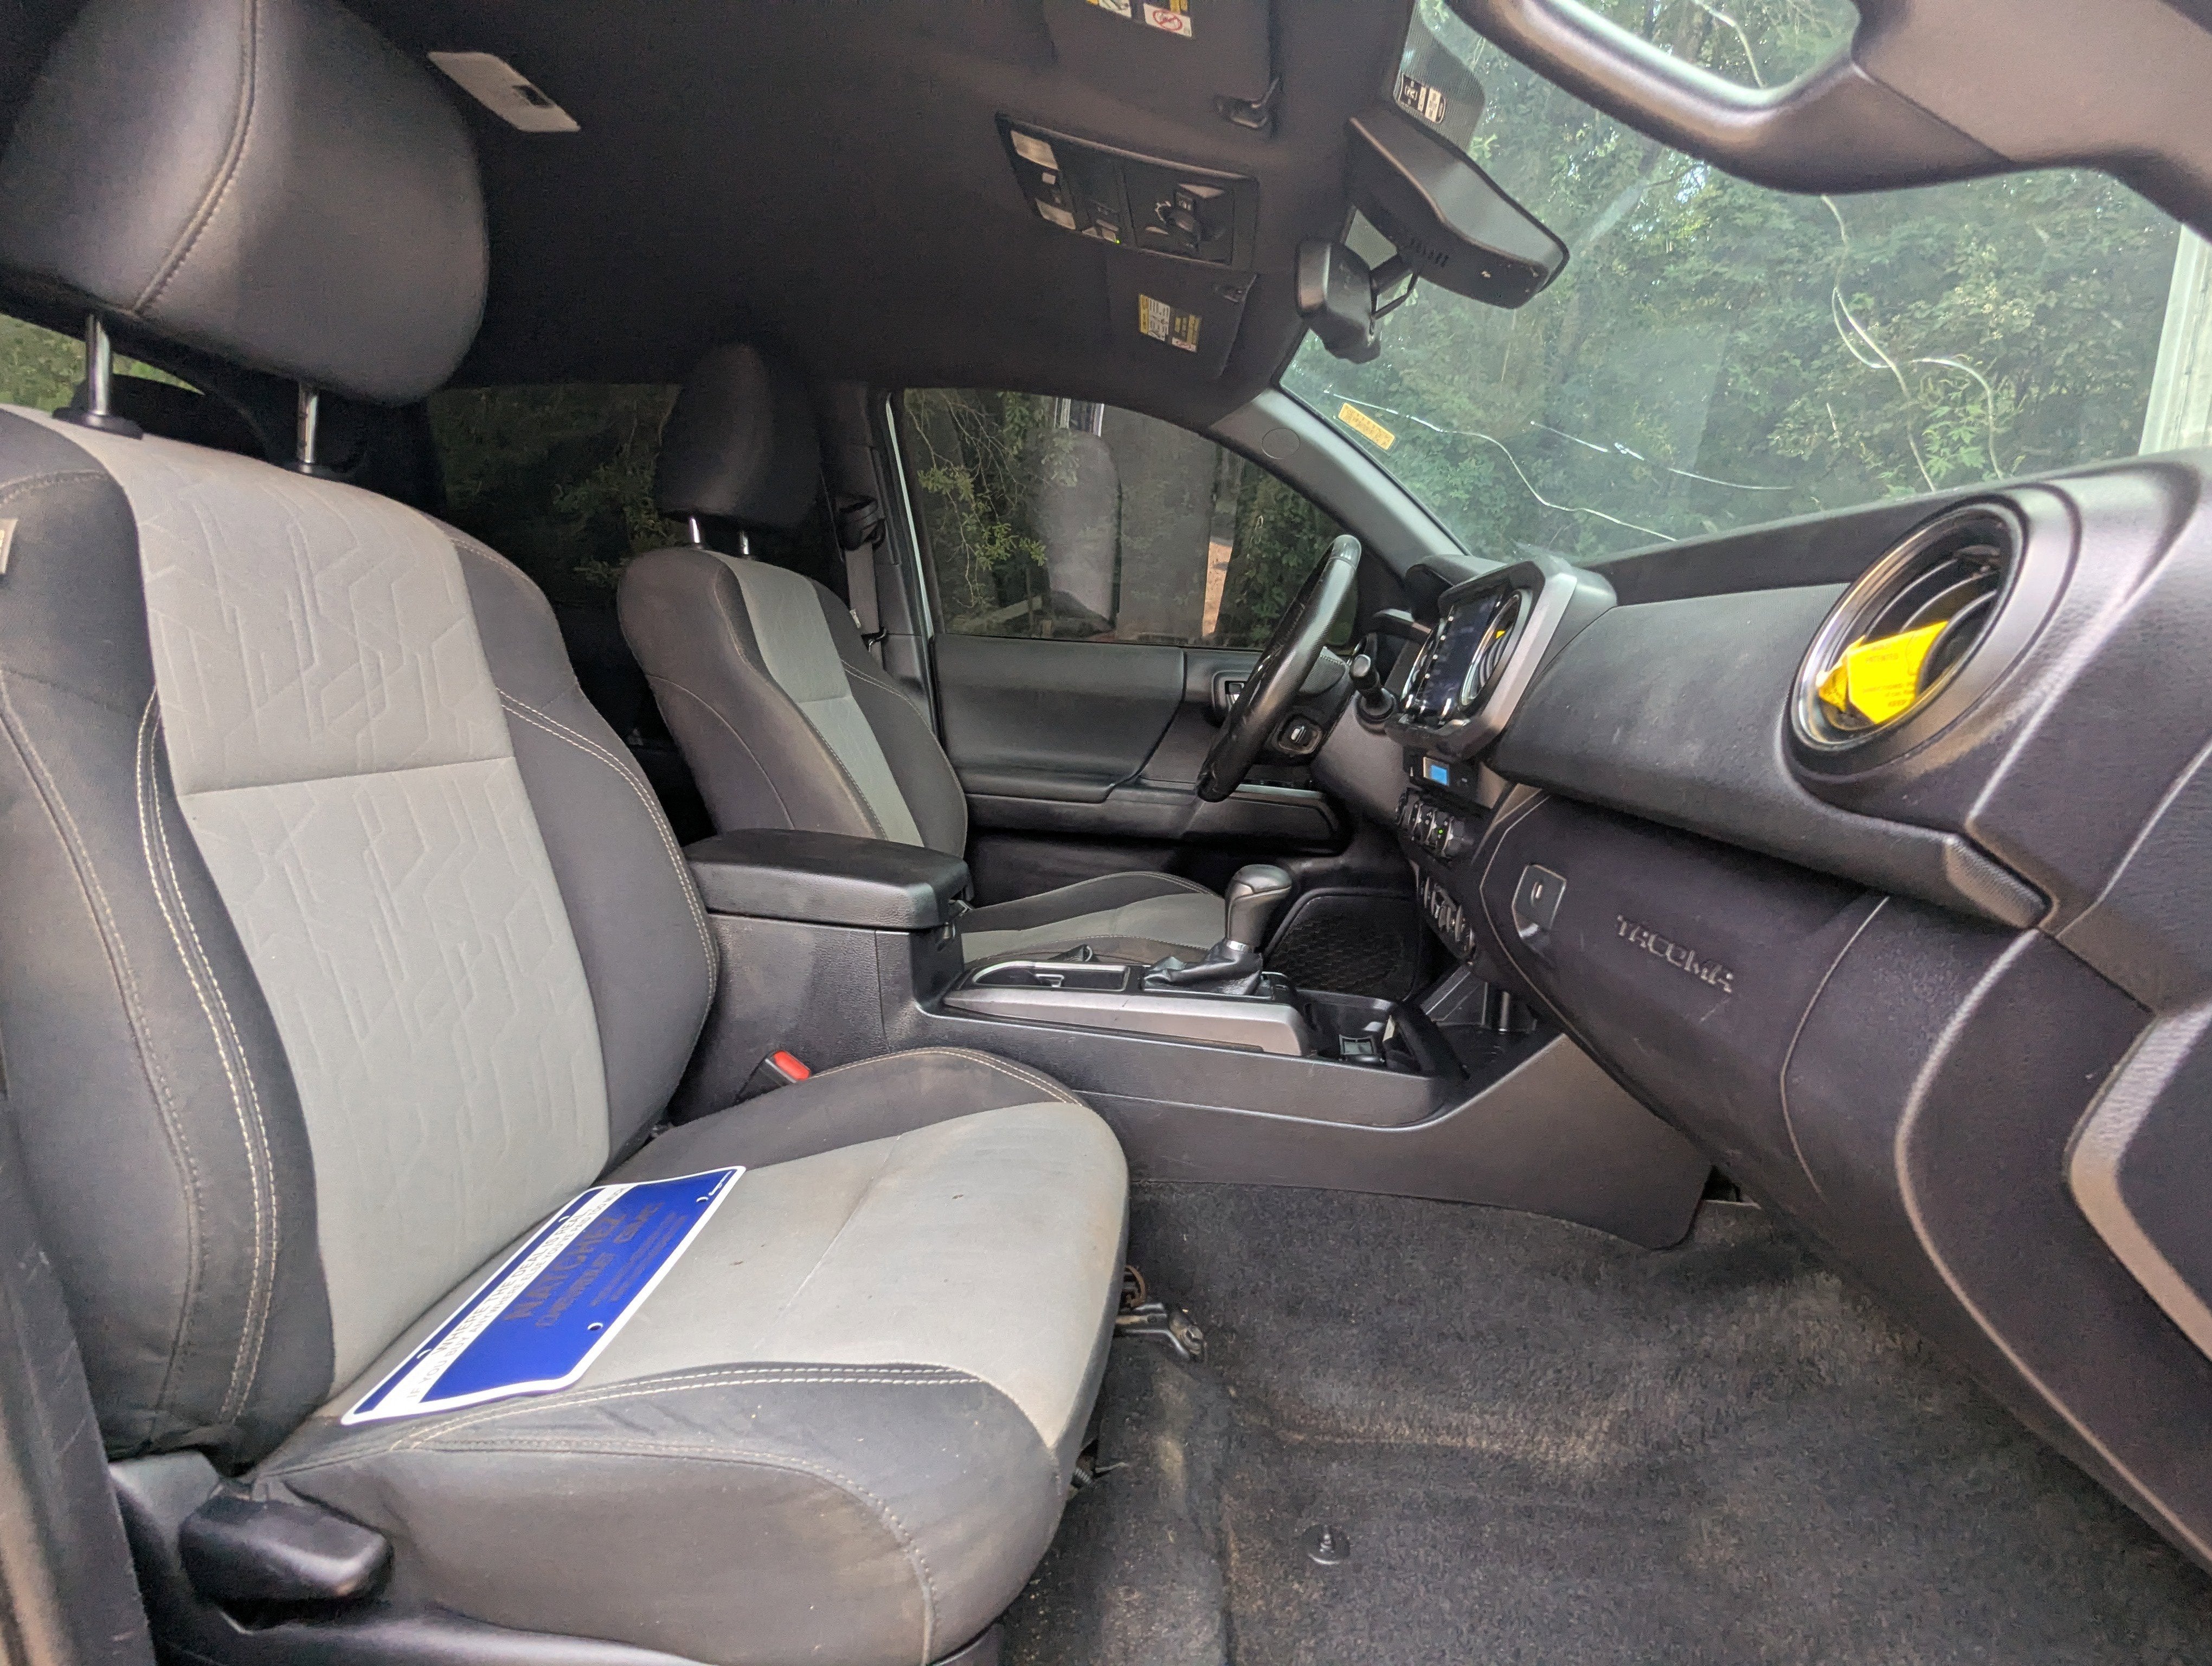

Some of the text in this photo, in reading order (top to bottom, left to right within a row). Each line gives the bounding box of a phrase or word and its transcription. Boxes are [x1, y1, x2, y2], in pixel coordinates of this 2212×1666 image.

[406, 1387, 421, 1397] IF
[417, 1360, 448, 1384] YOU
[443, 1337, 469, 1357] BUY
[468, 1282, 525, 1331] ANYWHERE
[520, 1260, 546, 1280] ELSE
[541, 1232, 575, 1259] YOU'VE
[570, 1217, 590, 1232] PAID
[586, 1203, 606, 1216] TOO
[430, 1305, 491, 1355] WHERE
[483, 1279, 517, 1304] THE
[508, 1248, 549, 1278] DEAL
[540, 1236, 561, 1247] IS
[503, 1214, 627, 1319] NATCHEZ
